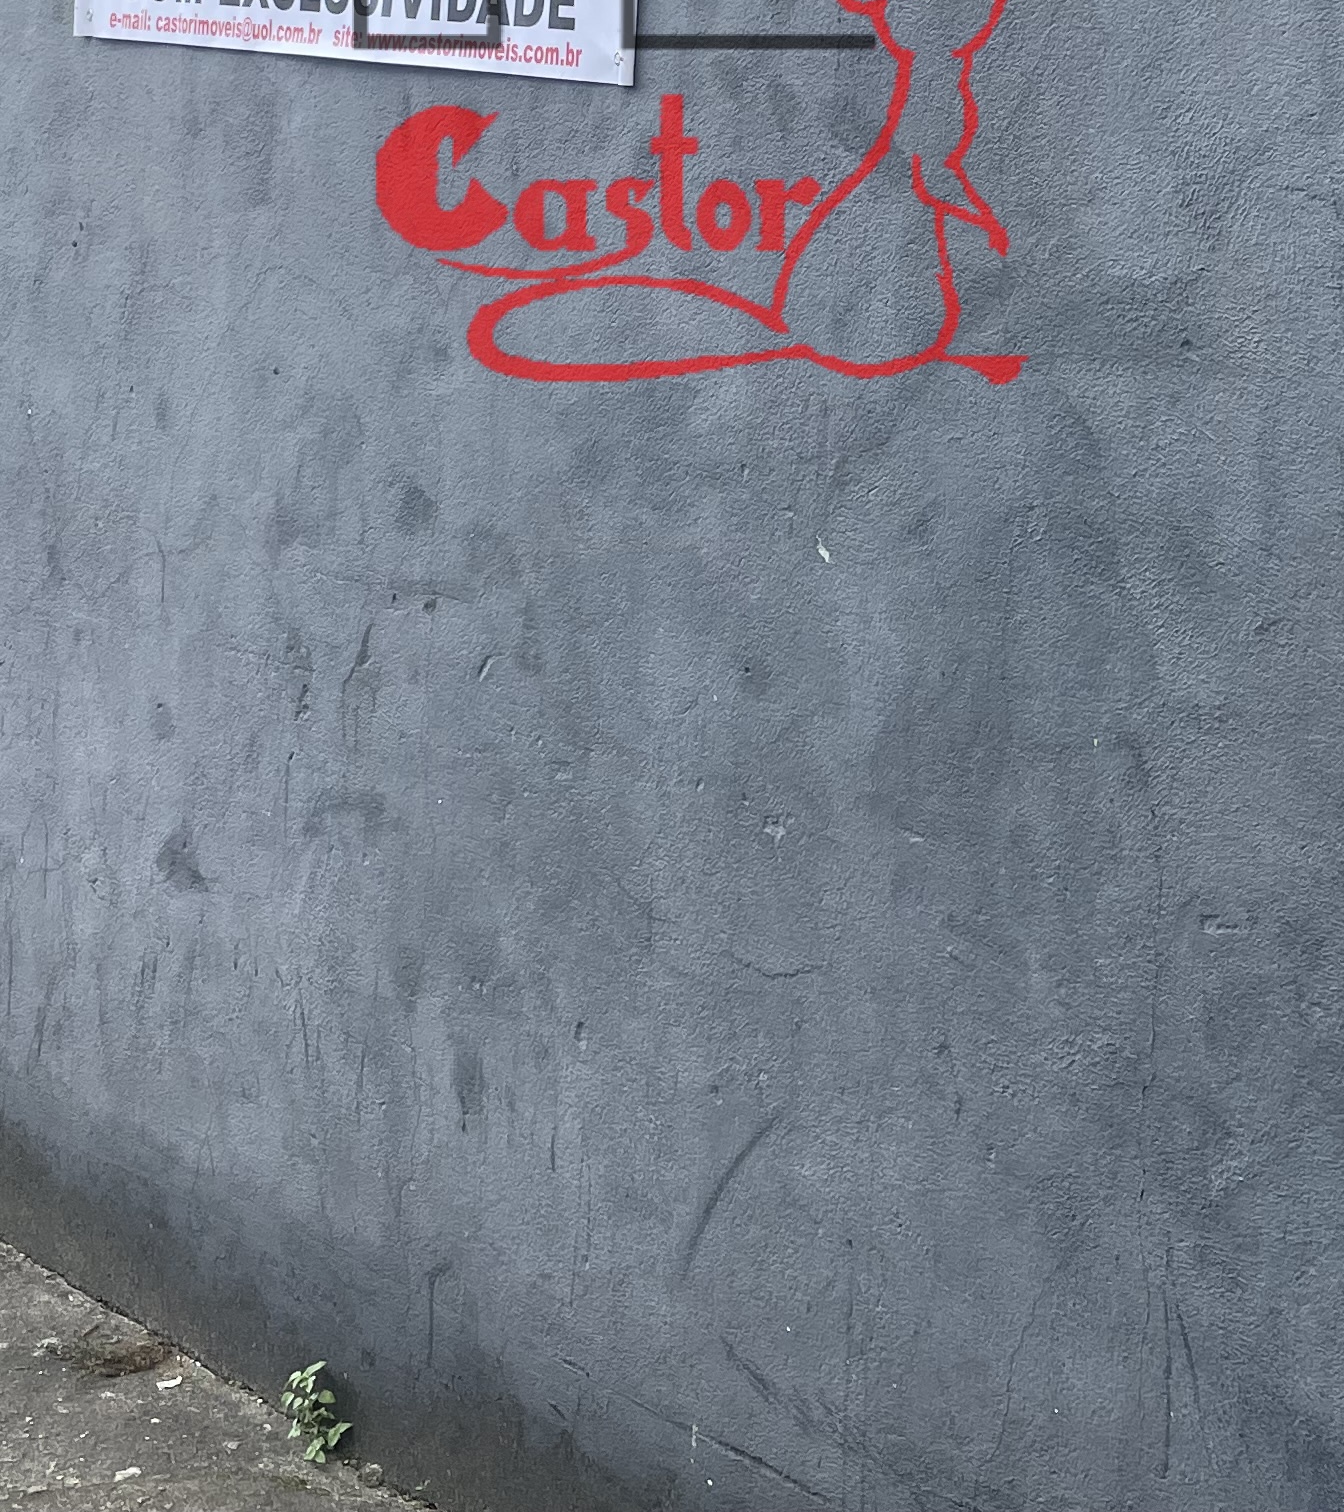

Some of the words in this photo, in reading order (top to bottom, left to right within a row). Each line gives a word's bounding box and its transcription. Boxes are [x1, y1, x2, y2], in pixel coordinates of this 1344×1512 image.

[109, 9, 152, 32] e-mail:
[155, 12, 323, 45] castorimoveis@uol.com.br
[332, 22, 363, 49] site:
[367, 32, 583, 68] www.castorimoveis.com.br
